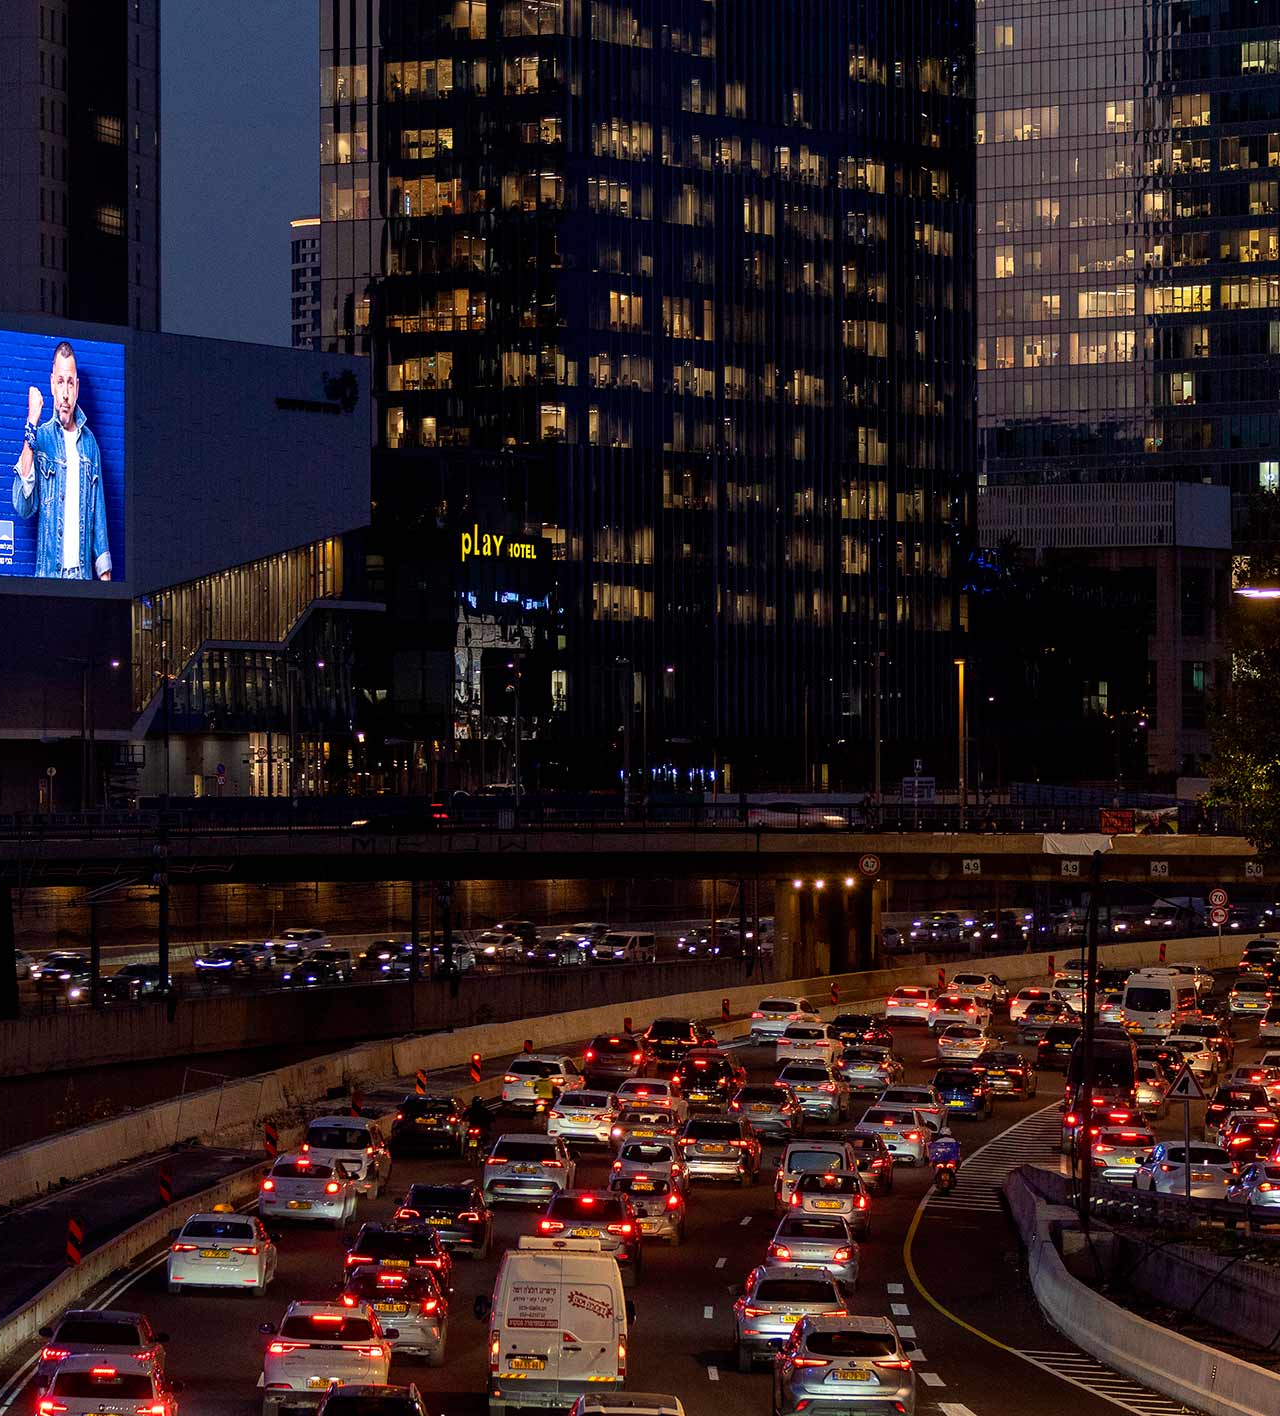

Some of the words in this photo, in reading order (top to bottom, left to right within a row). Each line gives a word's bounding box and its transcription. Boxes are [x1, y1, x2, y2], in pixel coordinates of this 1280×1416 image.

[507, 543, 537, 560] HOTEL
[964, 862, 979, 871] 4.9
[1063, 864, 1078, 873] 4.9
[1152, 864, 1167, 873] 4.9
[1247, 865, 1262, 874] 5.0
[1214, 894, 1224, 902] 70
